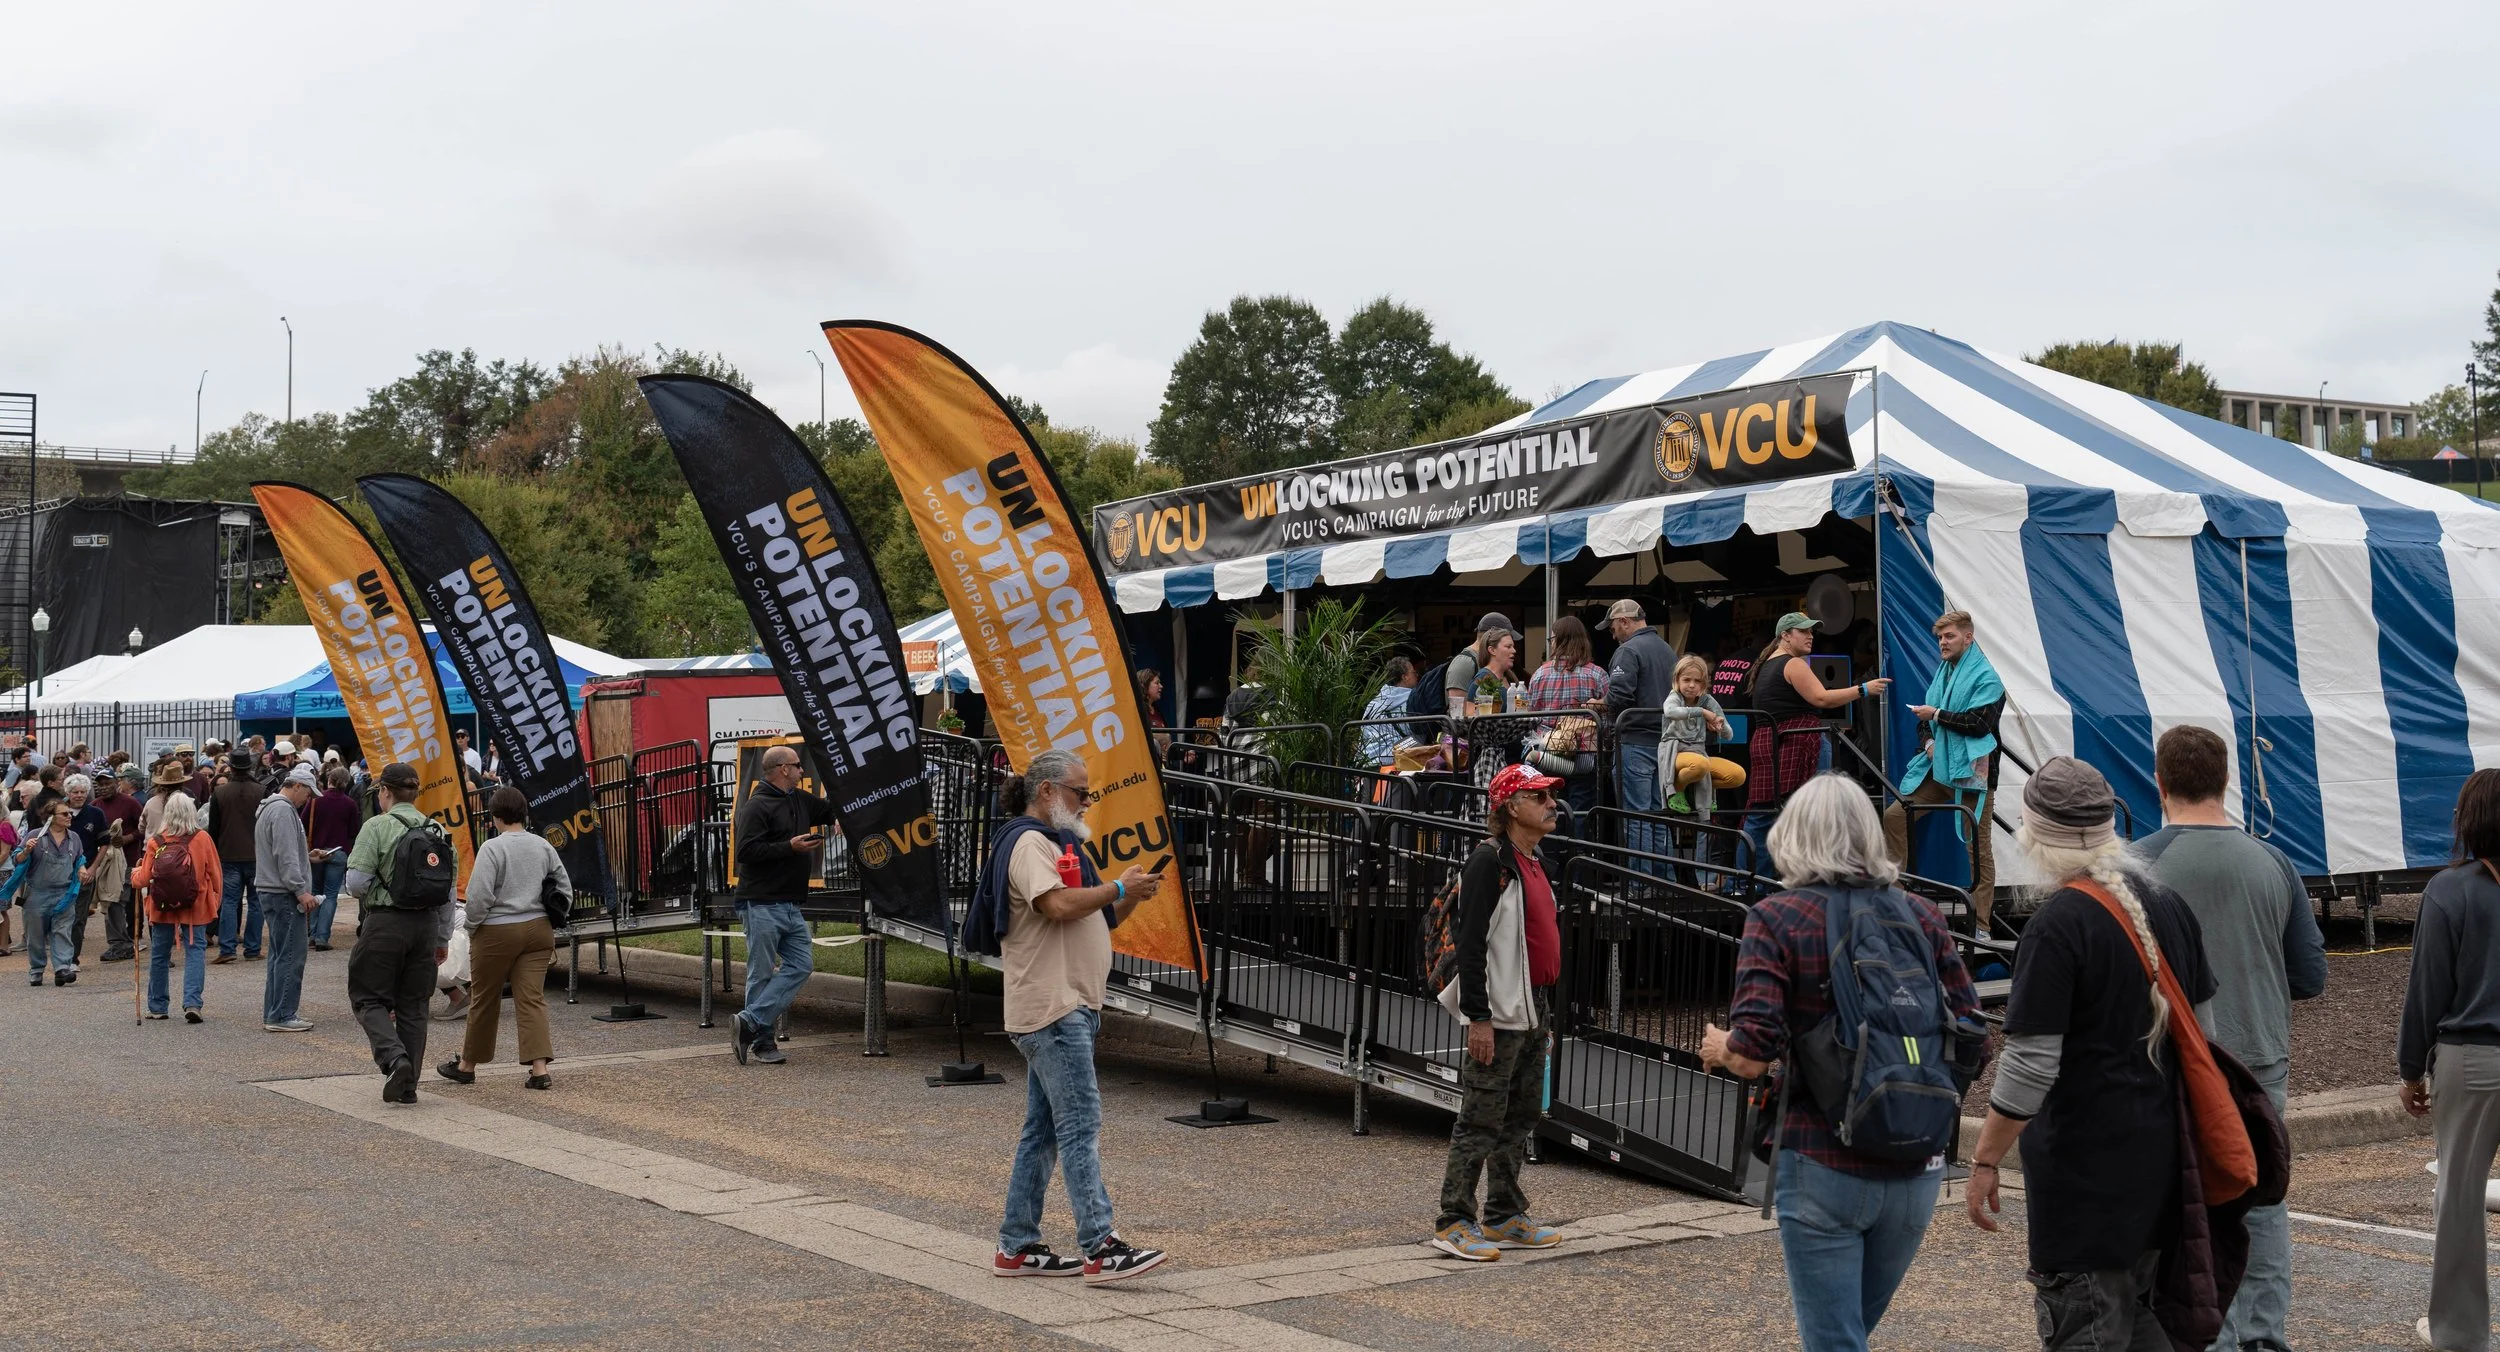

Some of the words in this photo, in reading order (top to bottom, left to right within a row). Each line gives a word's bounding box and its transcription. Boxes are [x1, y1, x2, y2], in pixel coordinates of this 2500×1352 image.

[1240, 462, 1408, 521] UNLOCKING
[1416, 427, 1598, 493] POTENTIAL
[1700, 395, 1818, 471] VCU
[1135, 503, 1207, 557] VCU
[1282, 519, 1329, 541] VCU'S
[1334, 505, 1421, 535] CAMPAIGN
[1422, 503, 1445, 529] for
[1446, 502, 1466, 519] the
[1468, 486, 1539, 517] FUTURE
[726, 520, 758, 572] VCU'S
[753, 576, 802, 670] CAMPAIGN
[789, 668, 809, 689] for
[803, 689, 817, 709] the
[811, 709, 849, 777] FUTURE
[745, 502, 881, 768] POTENTIAL
[785, 487, 917, 752] UNLOCKING
[922, 485, 957, 543] VCU'S
[950, 549, 1000, 652] CAMPAIGN
[989, 654, 1008, 678] for
[1001, 677, 1016, 700] the
[1011, 701, 1041, 754] FUTU
[941, 466, 1089, 752] POTENTIAL
[987, 451, 1125, 753] UNLOCKING
[331, 632, 364, 698] CAMPAIGN
[371, 729, 390, 763] FUTU
[357, 569, 441, 763] UNLOCKING
[426, 584, 452, 623] VCU'S
[451, 627, 489, 696] CAMPAIGN
[482, 698, 496, 715] for
[492, 711, 503, 728] the
[500, 727, 532, 780] FUTURE
[439, 568, 556, 773] POTENTIAL
[469, 555, 576, 760] UNLOCKING
[911, 650, 935, 664] BEER
[1712, 684, 1735, 695] STAFF
[1714, 671, 1743, 682] BOOTH
[1720, 660, 1751, 670] PHOTO
[562, 809, 594, 840] VC
[842, 776, 921, 813] unlocking.vcu.
[887, 815, 936, 855] VC
[1084, 815, 1170, 871] VCU
